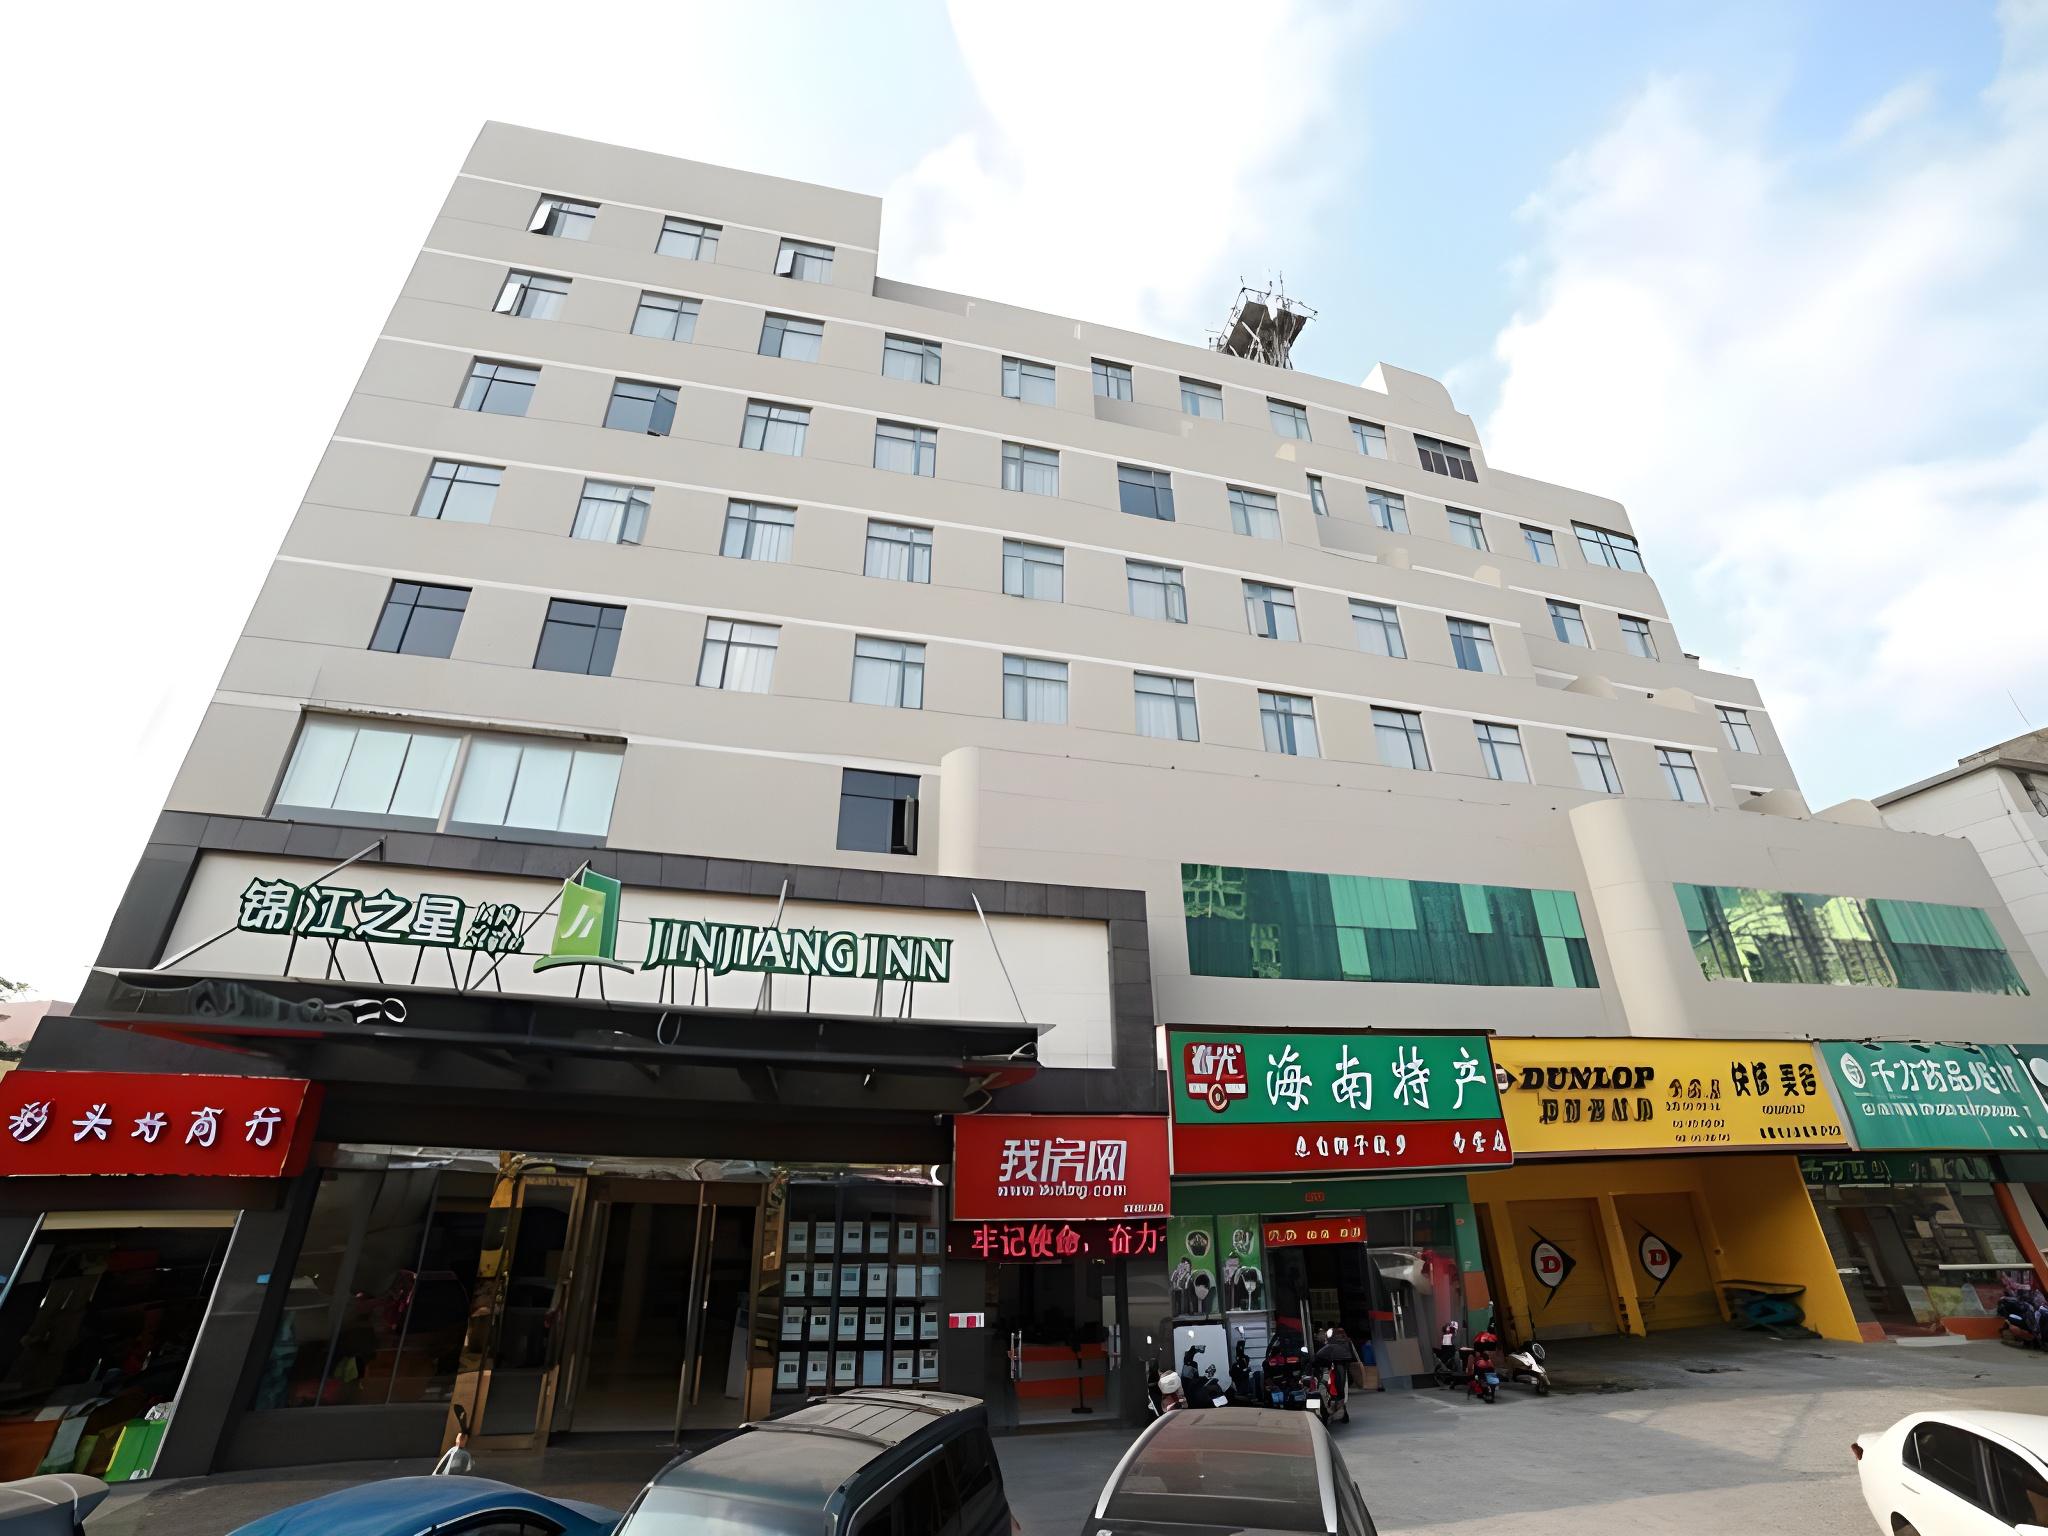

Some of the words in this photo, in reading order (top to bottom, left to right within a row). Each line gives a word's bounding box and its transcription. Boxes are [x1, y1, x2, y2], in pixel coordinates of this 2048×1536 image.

[239, 878, 465, 946] 锦江之星
[1266, 1044, 1487, 1111] 海南特产
[1518, 1066, 1655, 1091] DUNLOP
[999, 1137, 1128, 1182] 我房网
